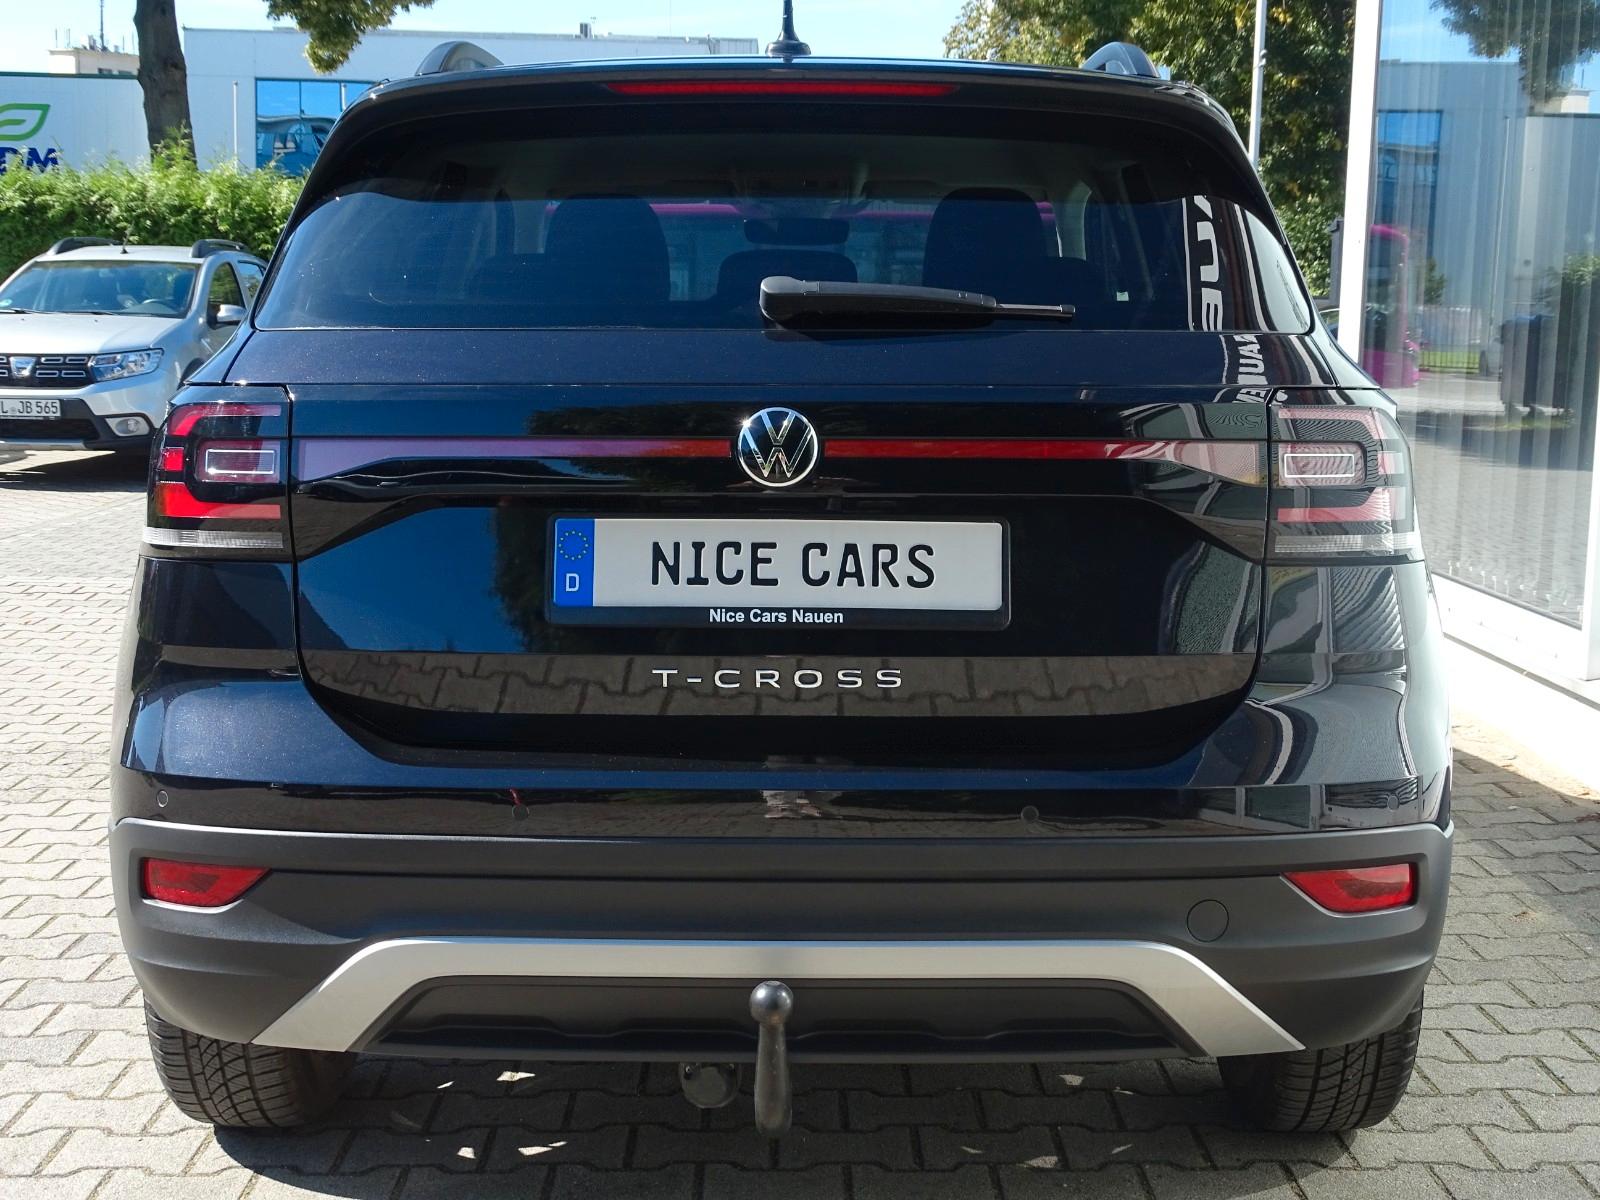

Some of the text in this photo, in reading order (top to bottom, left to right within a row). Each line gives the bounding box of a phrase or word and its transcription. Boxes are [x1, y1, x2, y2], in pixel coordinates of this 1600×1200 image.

[17, 400, 33, 414] JB
[35, 401, 58, 414] 565
[741, 409, 815, 480] VW
[651, 541, 935, 589] NICE CARS
[565, 573, 580, 592] D
[709, 608, 844, 623] Nice Cars Nauen
[651, 669, 902, 689] T-CROSS
